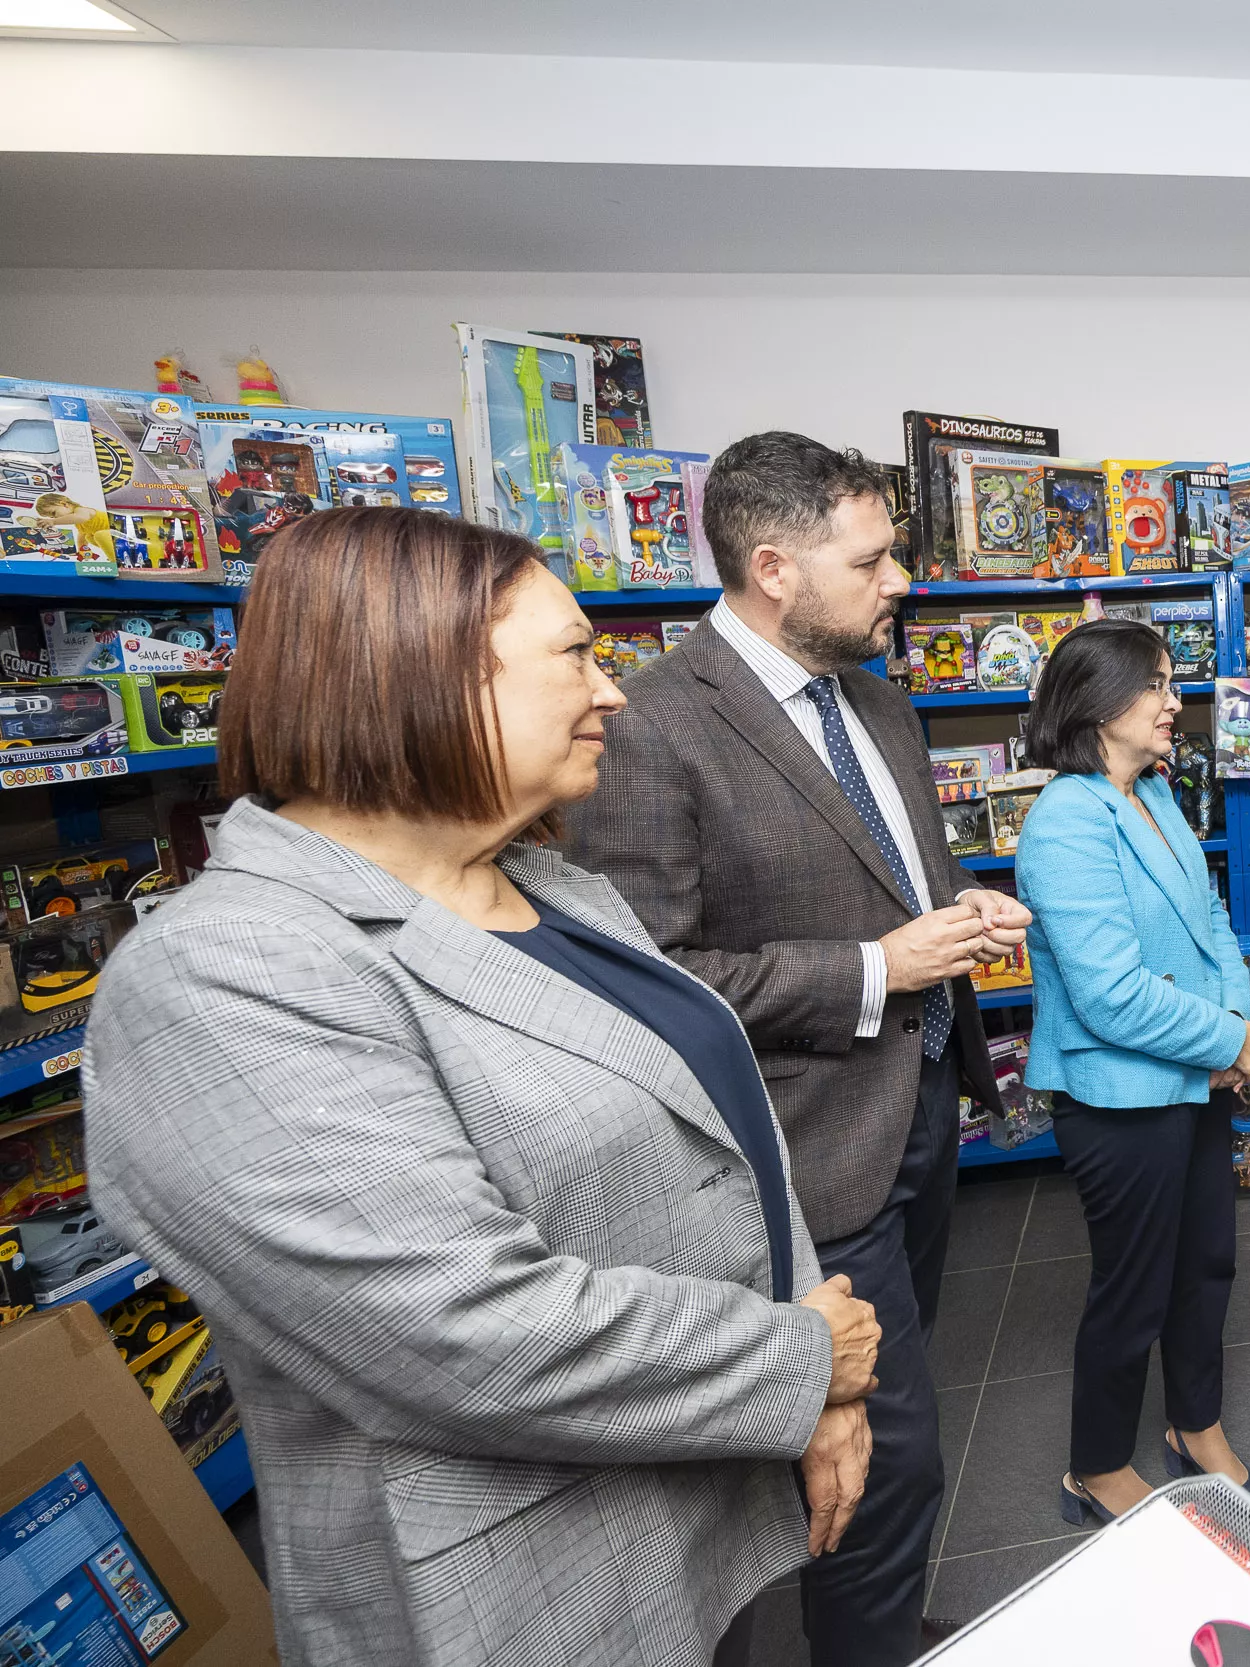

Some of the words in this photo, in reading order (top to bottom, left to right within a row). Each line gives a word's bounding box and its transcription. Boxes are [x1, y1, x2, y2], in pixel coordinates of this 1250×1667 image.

[940, 419, 1022, 441] DINOSAURIOS
[906, 422, 917, 494] DINOSAURIOS
[148, 482, 189, 491] proportion
[1190, 474, 1221, 487] METAL
[81, 565, 113, 574] 24M+
[631, 561, 675, 586] Baby
[1153, 602, 1209, 619] perplexus
[137, 649, 179, 661] SAVAGE
[993, 653, 1015, 662] DINO
[1174, 663, 1199, 674] REBEL
[12, 751, 47, 762] TRUCK
[48, 747, 83, 758] SERIES
[3, 764, 64, 786] COCHES
[66, 764, 77, 778] Y
[82, 759, 126, 777] PISTAS
[51, 1004, 91, 1025] SUPER
[141, 1613, 174, 1644] Service
[146, 1620, 177, 1651] BOSCH
